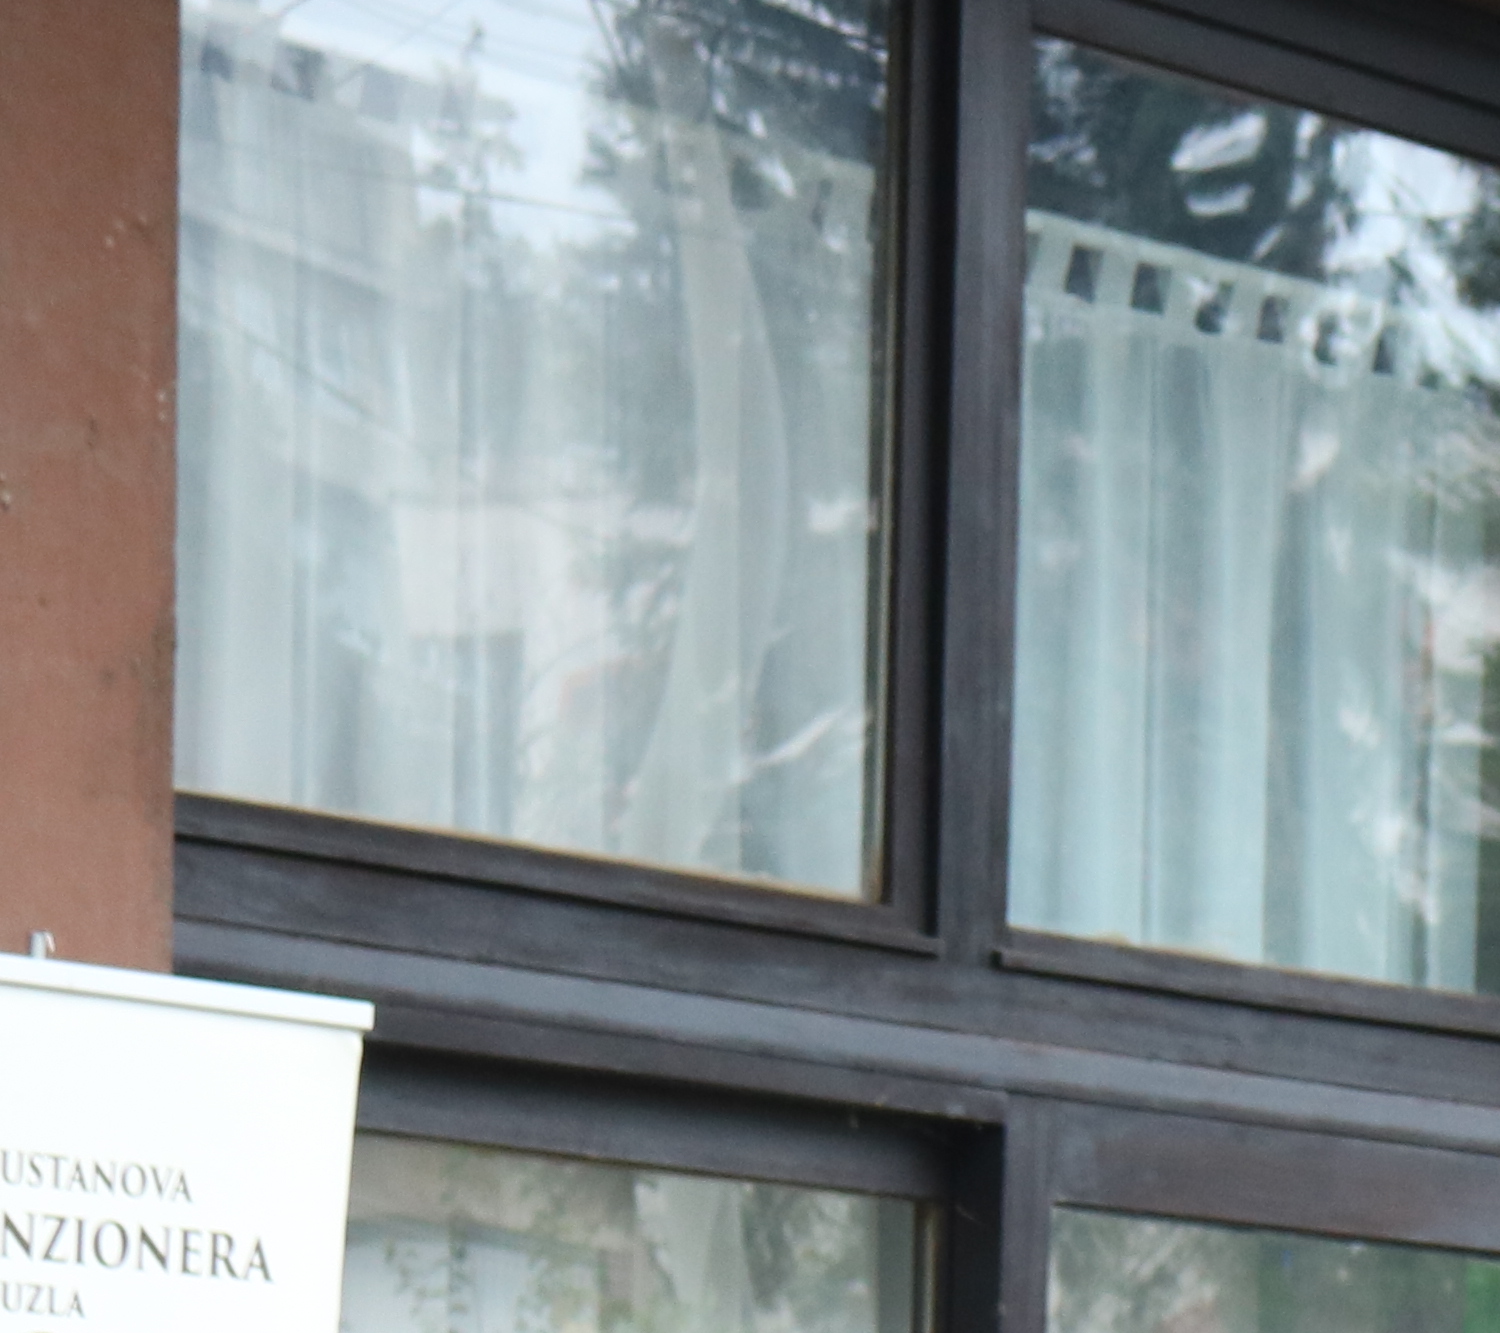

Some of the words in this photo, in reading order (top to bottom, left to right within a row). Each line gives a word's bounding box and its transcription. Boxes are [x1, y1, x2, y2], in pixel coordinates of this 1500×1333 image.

[0, 1149, 193, 1203] USTANOVA
[0, 1210, 274, 1283] NZIONERA
[0, 1280, 85, 1319] UZLA
